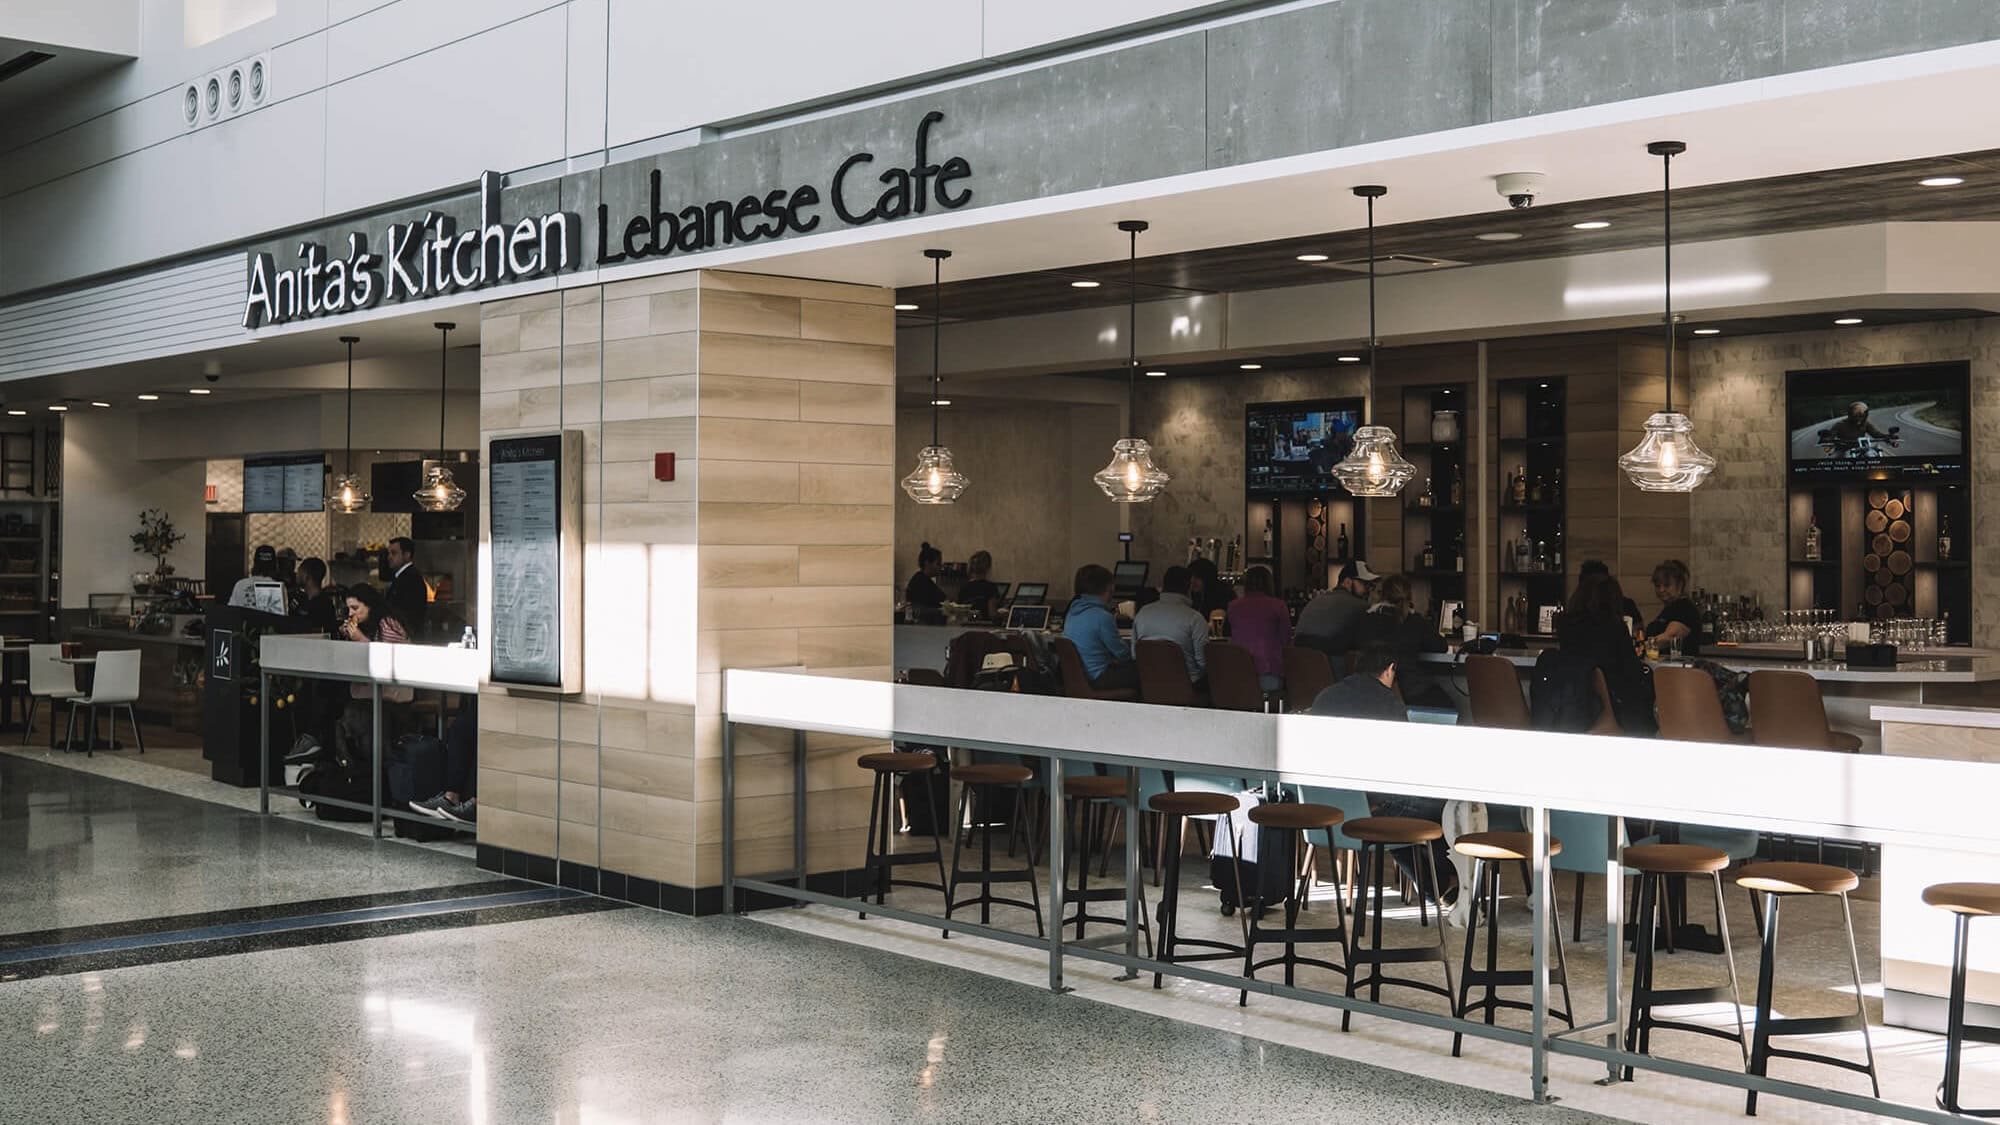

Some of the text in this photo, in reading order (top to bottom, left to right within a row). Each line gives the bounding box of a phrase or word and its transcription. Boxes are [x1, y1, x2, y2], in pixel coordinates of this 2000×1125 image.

[242, 111, 973, 327] Anita's Kitchen Lebanese Cafe
